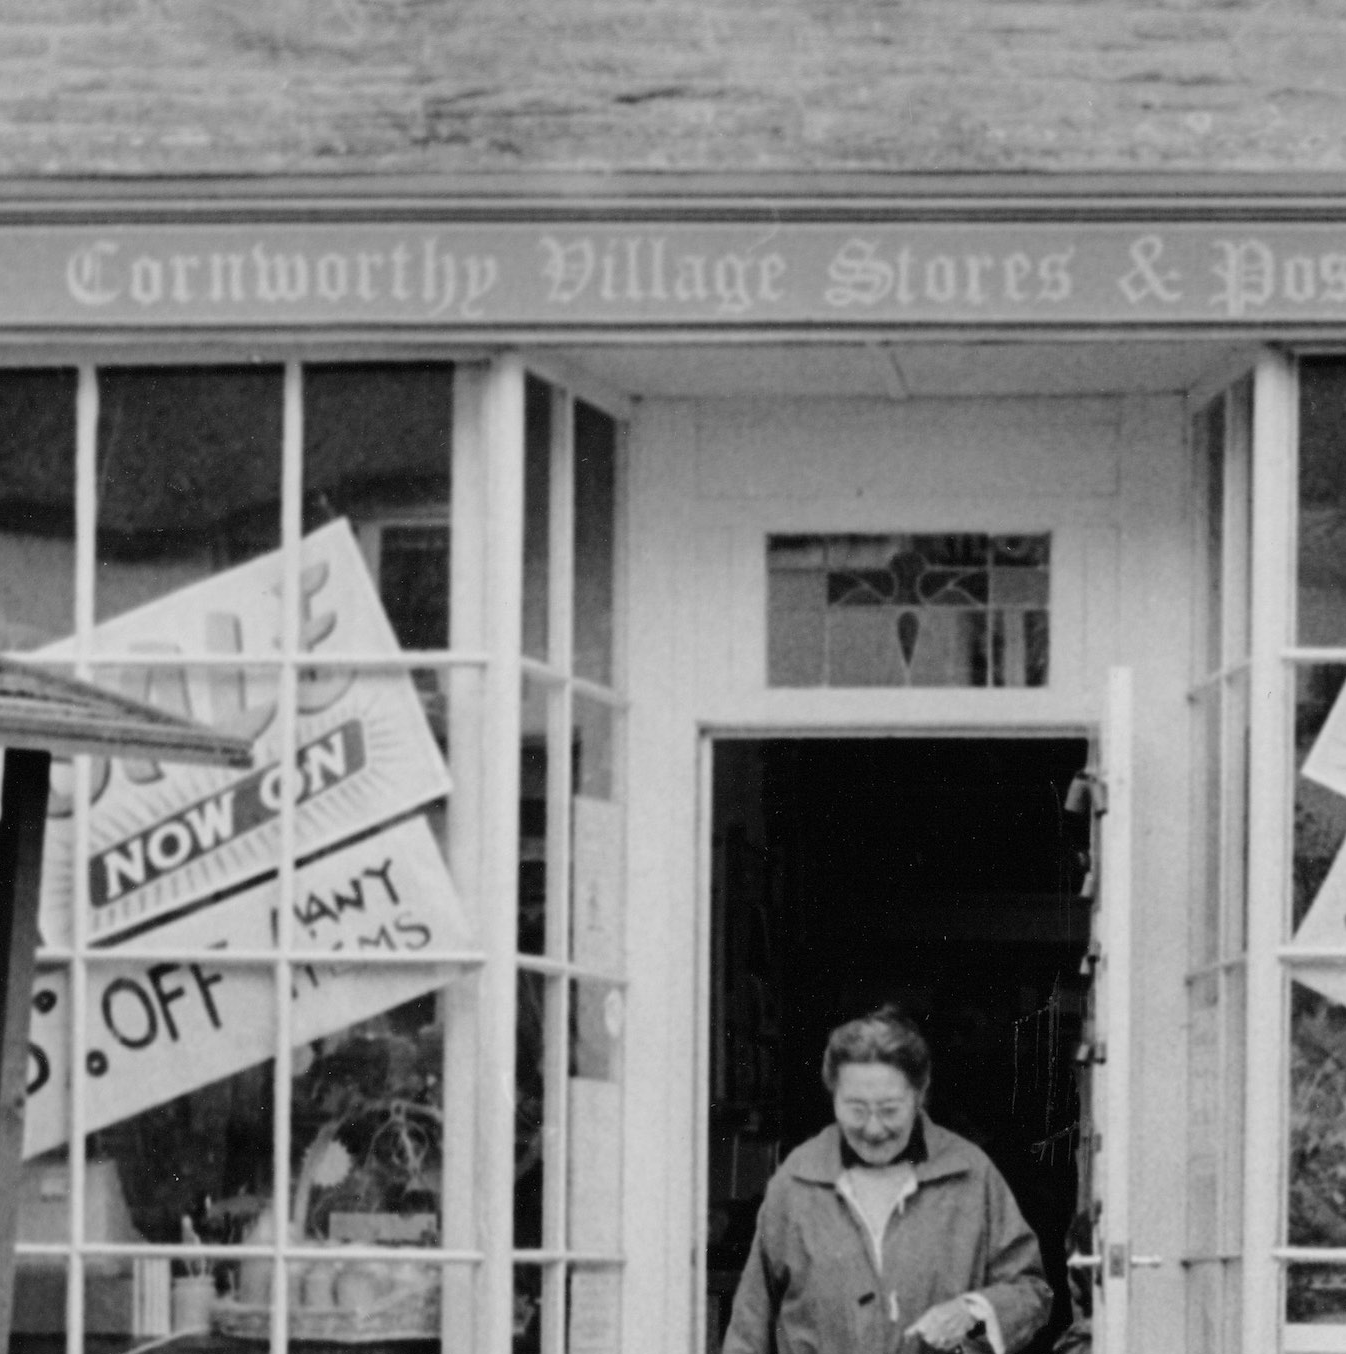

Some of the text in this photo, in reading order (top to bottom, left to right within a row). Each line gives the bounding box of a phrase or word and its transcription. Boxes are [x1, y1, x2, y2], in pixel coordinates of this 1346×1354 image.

[66, 236, 498, 318] Cornworthy
[539, 235, 788, 314] Village
[823, 237, 1076, 307] Stores
[1117, 233, 1183, 304] &
[102, 728, 349, 898] NOW ON
[100, 940, 227, 1050] OFF
